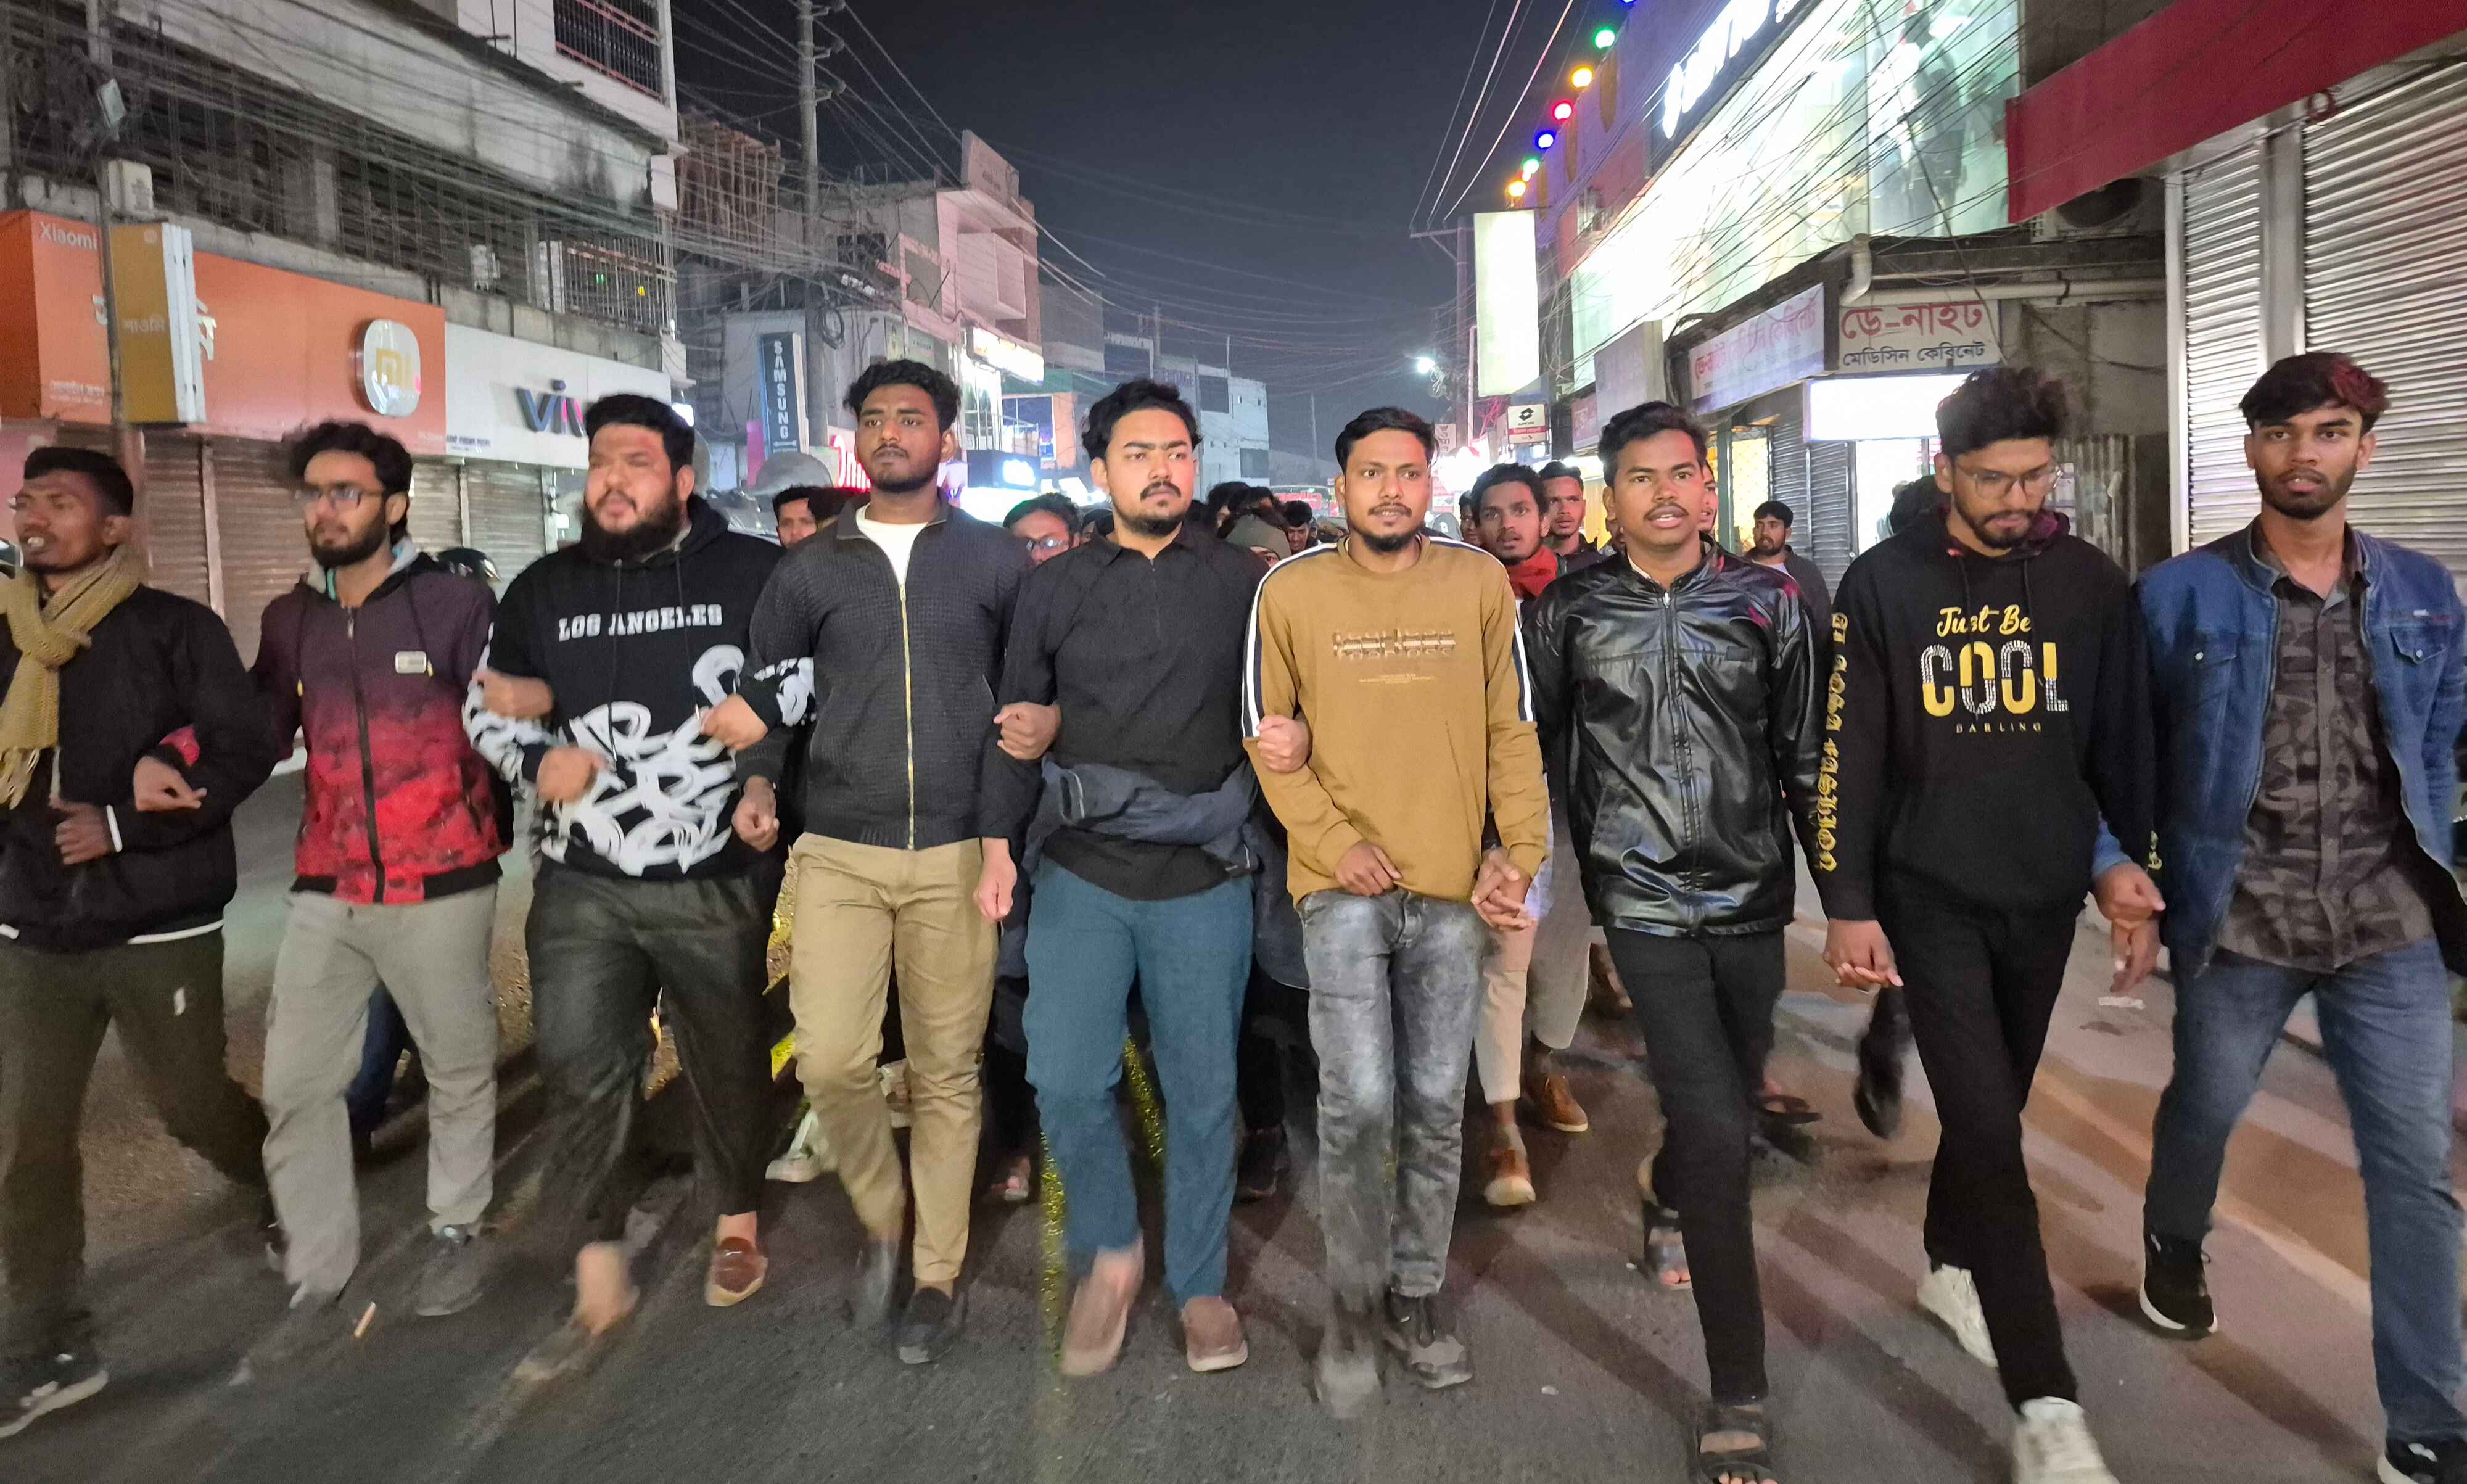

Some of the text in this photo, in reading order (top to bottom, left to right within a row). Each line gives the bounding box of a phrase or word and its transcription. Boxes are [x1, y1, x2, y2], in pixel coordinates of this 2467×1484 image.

[40, 222, 97, 249] Xiaomi
[1843, 346, 1910, 367] মেডিসিন
[773, 340, 789, 439] SAMSUNG
[1937, 604, 2032, 637] Just Be
[1921, 640, 2069, 717] COOL
